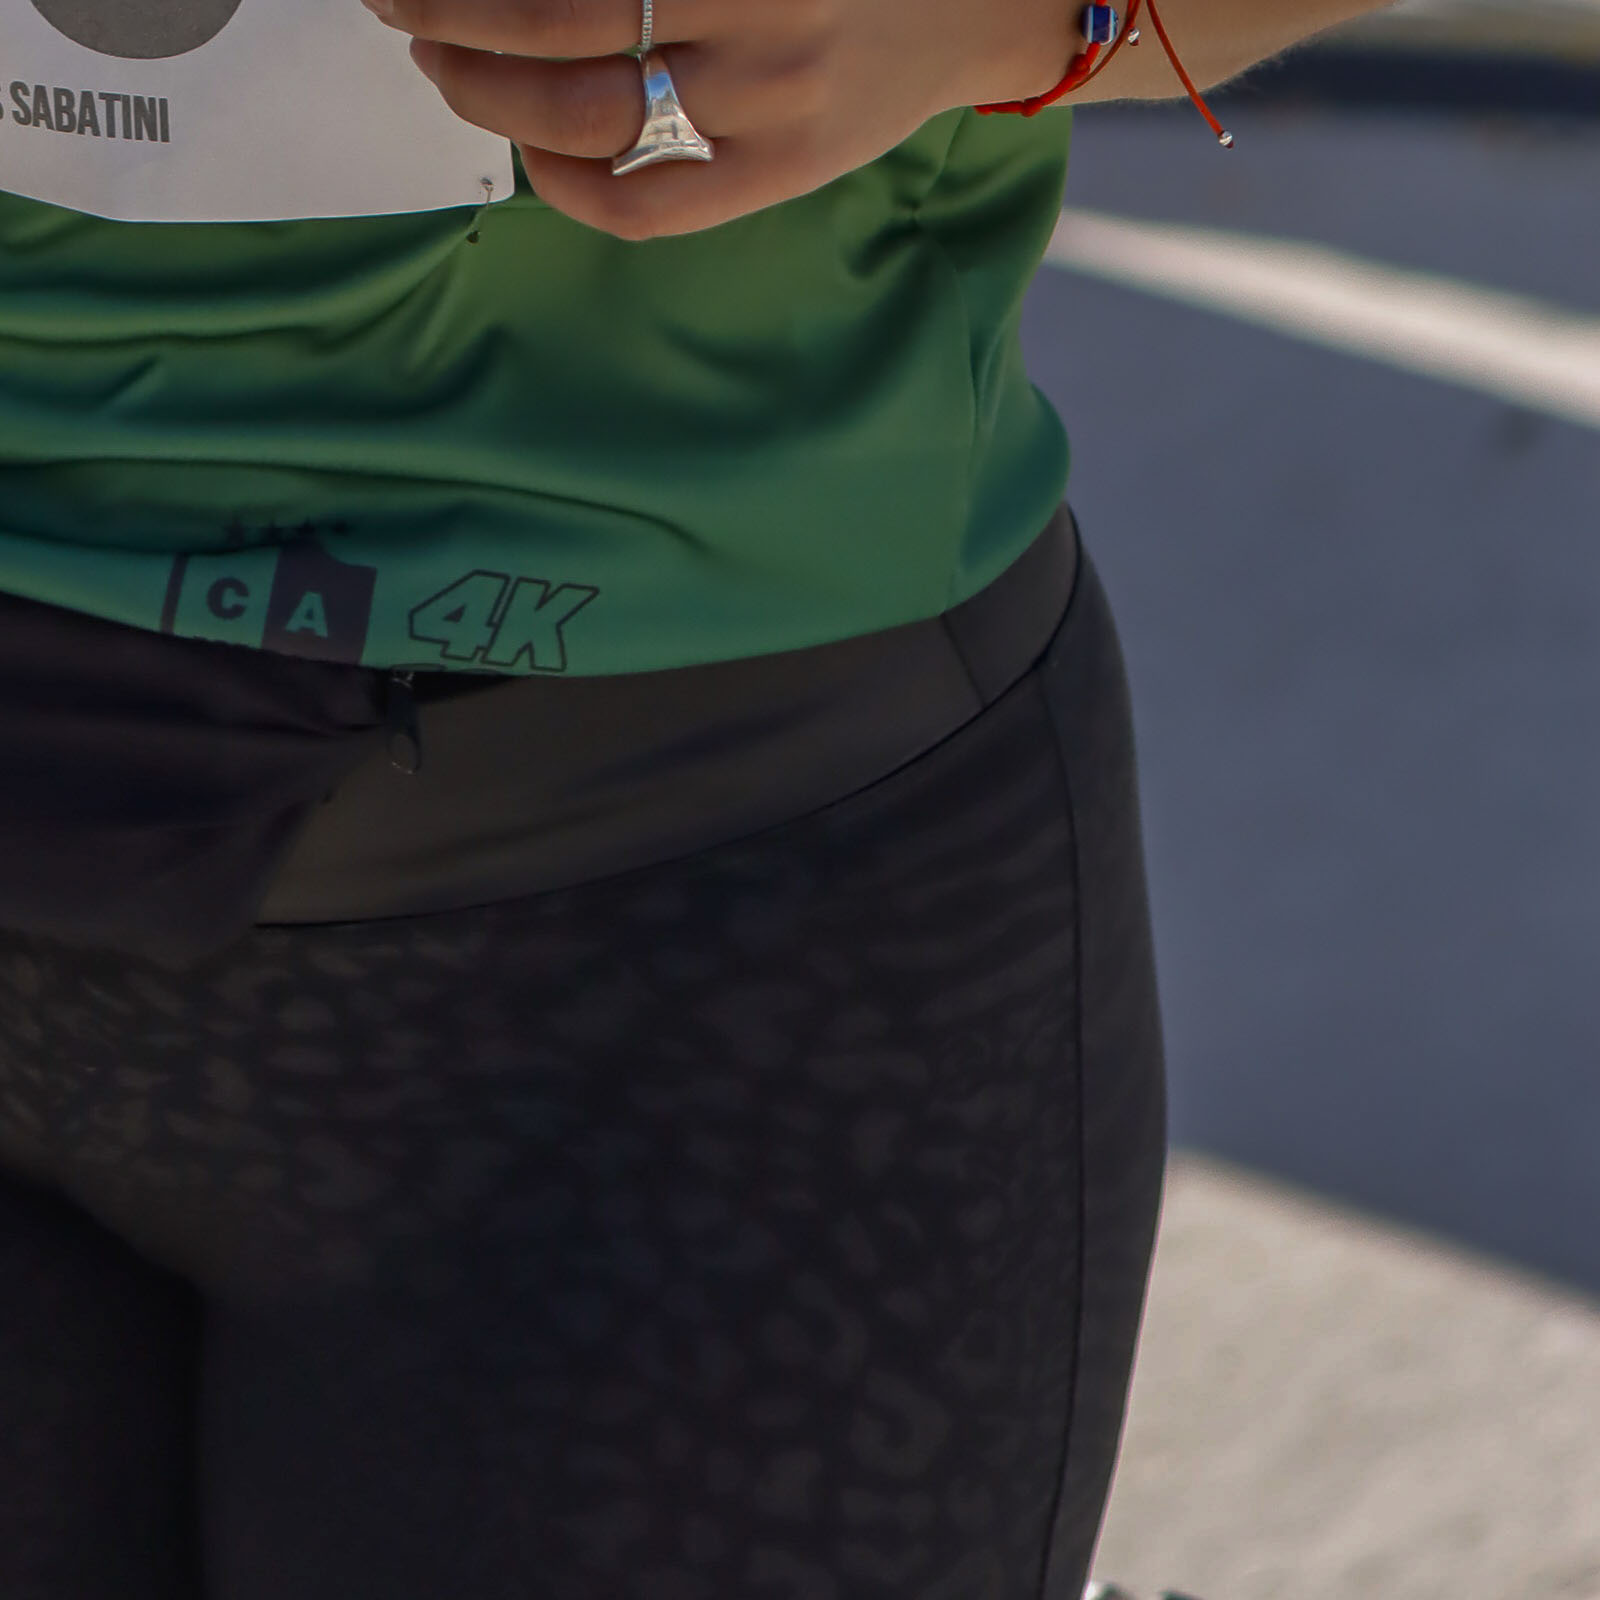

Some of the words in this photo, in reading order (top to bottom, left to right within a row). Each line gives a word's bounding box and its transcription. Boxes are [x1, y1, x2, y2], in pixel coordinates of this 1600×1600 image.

[9, 80, 171, 143] SABATINI
[205, 577, 250, 620] C
[286, 591, 329, 638] A
[408, 569, 601, 673] 4K
